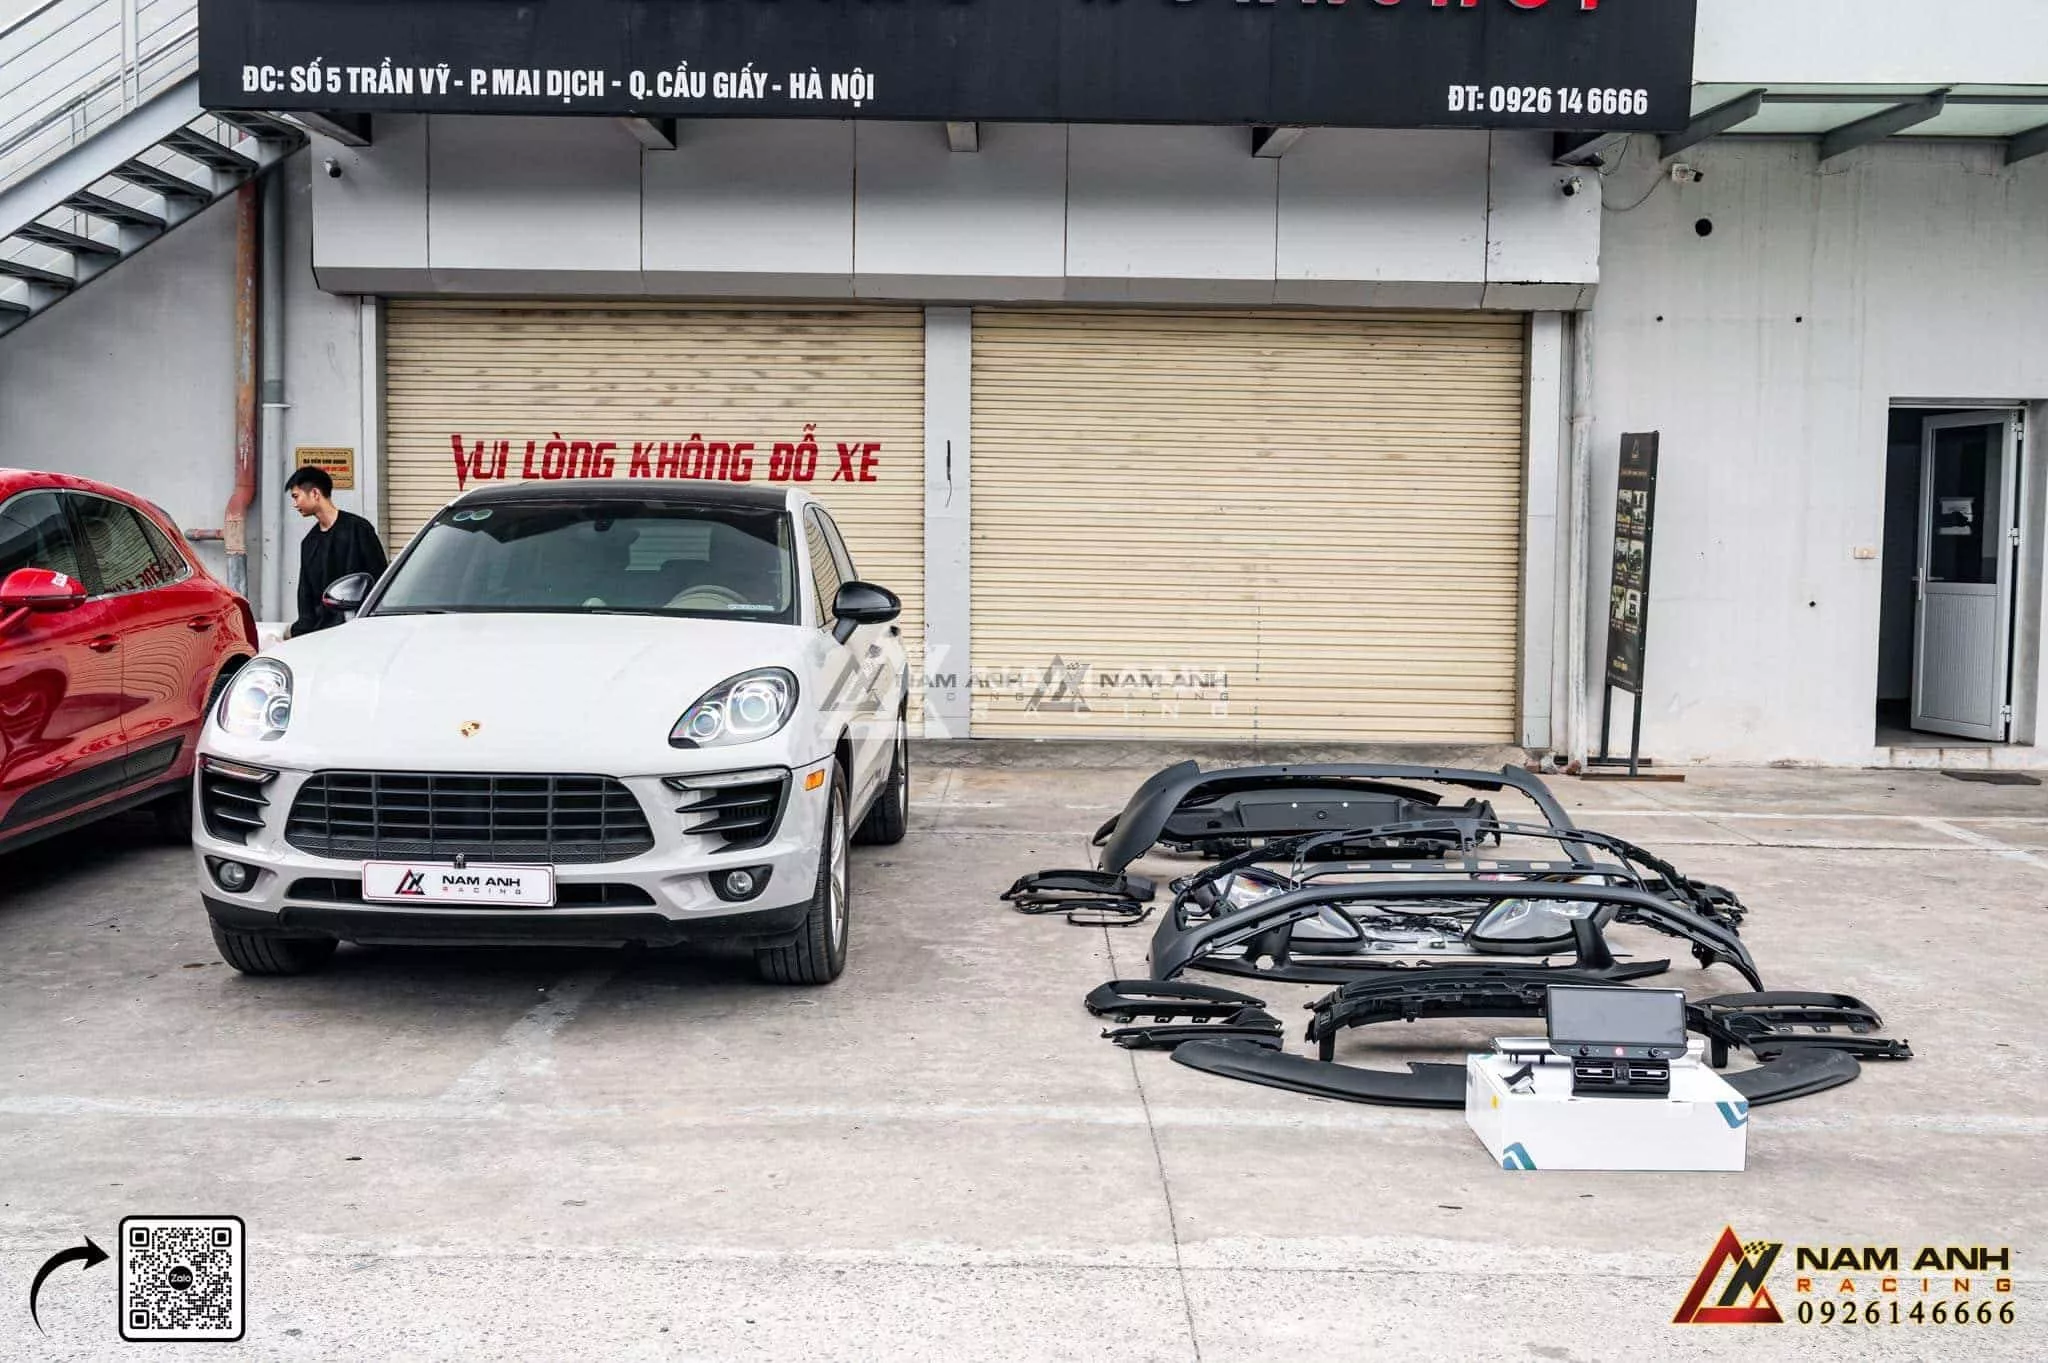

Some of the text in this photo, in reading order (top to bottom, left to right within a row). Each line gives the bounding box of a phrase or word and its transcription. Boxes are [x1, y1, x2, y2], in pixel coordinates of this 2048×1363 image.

[242, 65, 285, 93] ĐC:
[346, 57, 414, 94] TRẦN
[419, 62, 451, 95] VỸ
[546, 69, 604, 104] DỊCH
[712, 62, 769, 99] GIẤY
[789, 66, 824, 100] HÀ
[831, 67, 874, 108] NỘI
[1447, 85, 1648, 115] ĐT: 0926 14 6666
[450, 423, 882, 491] VUI LÒNG KHÔNG ĐỖ XE
[442, 875, 521, 887] NAM ANH
